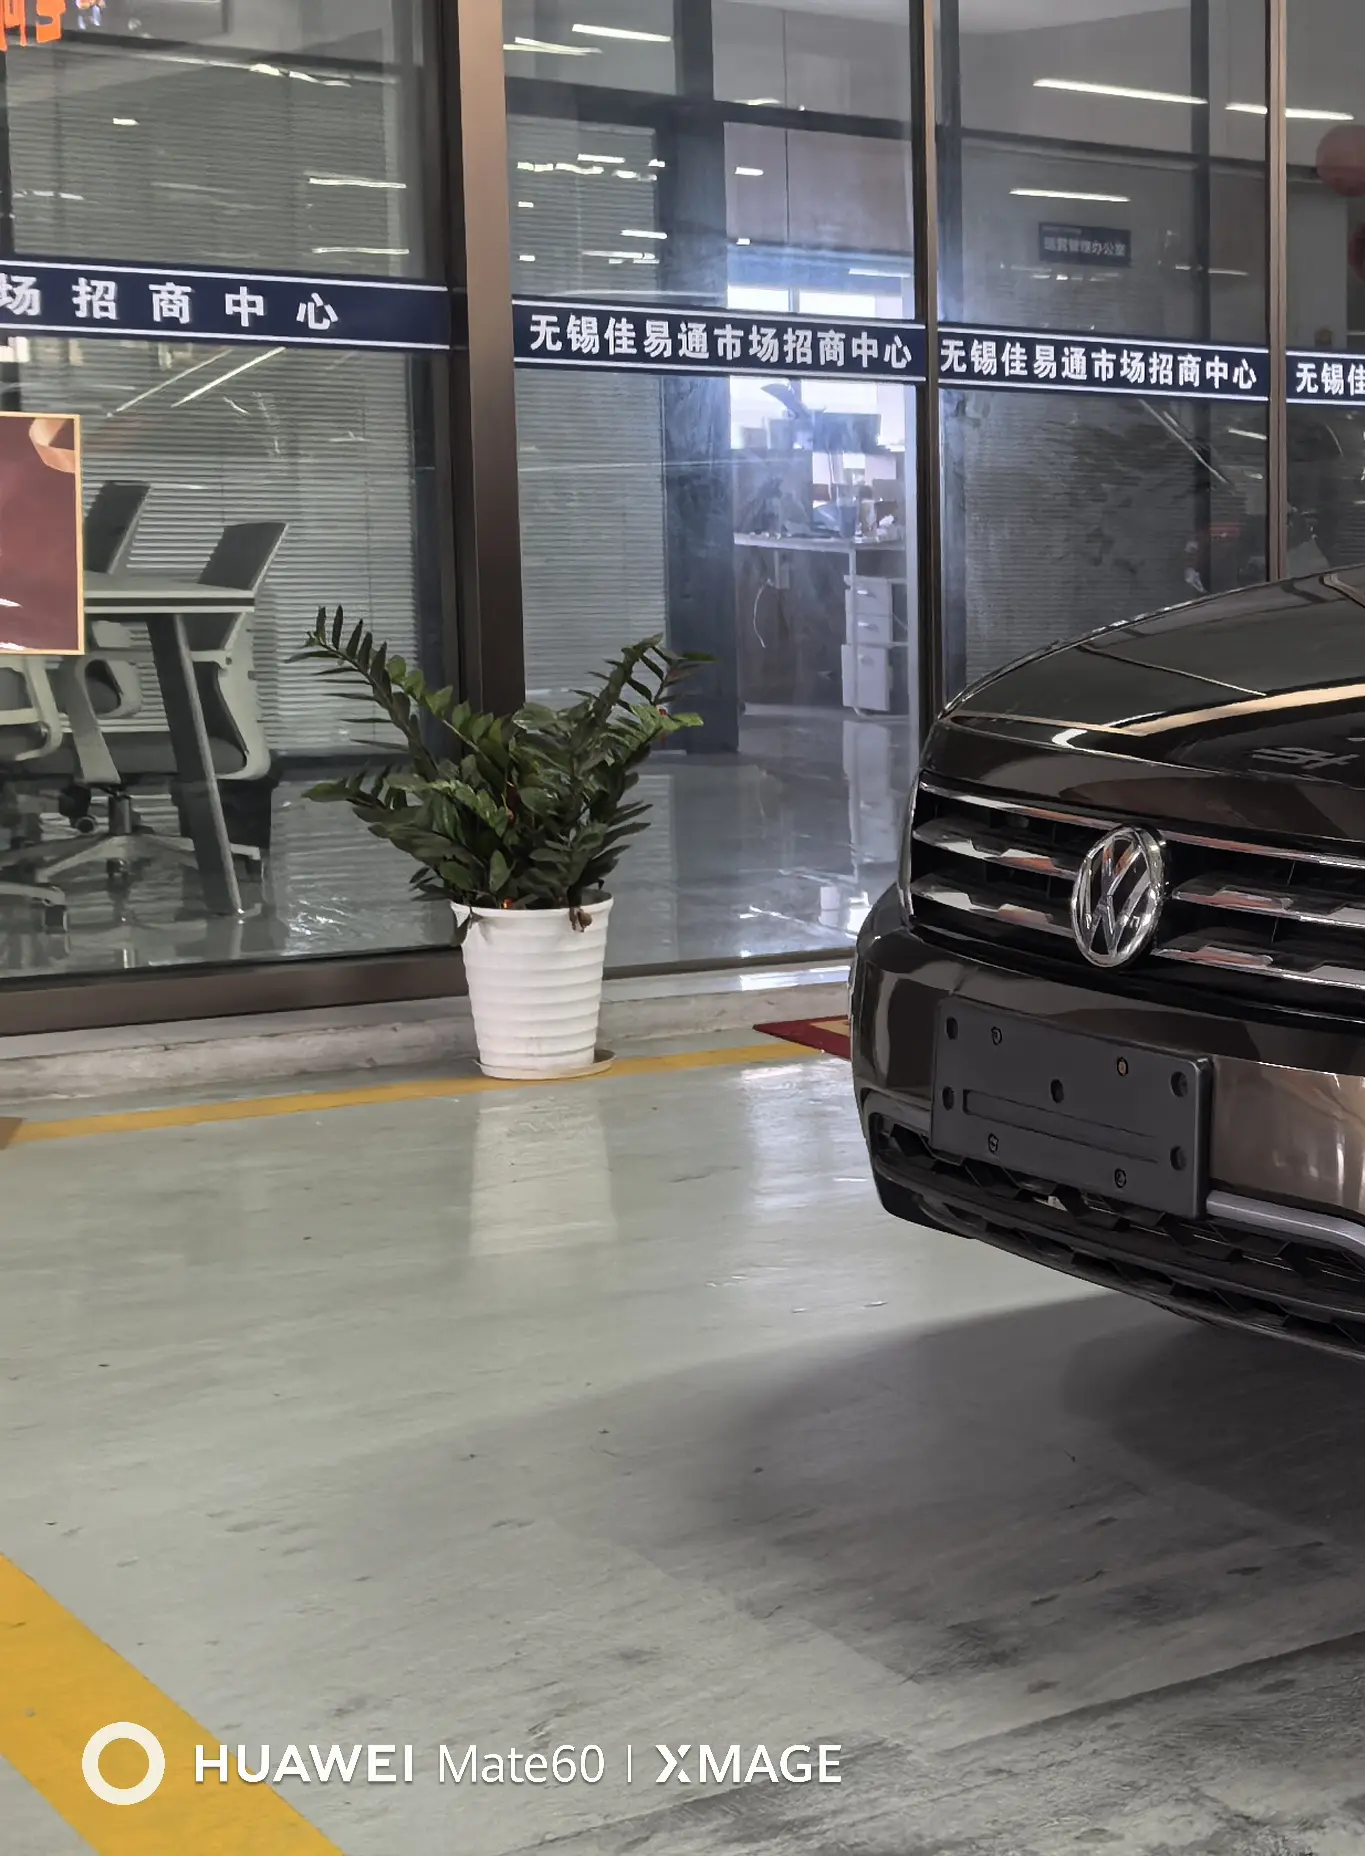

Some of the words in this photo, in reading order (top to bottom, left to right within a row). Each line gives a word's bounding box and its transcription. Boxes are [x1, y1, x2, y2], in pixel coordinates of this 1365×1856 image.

[0, 272, 339, 331] 场招商中心
[530, 313, 912, 369] 无锡佳易通市场招商中心
[940, 338, 1257, 389] 无锡佳易通市场招商中心
